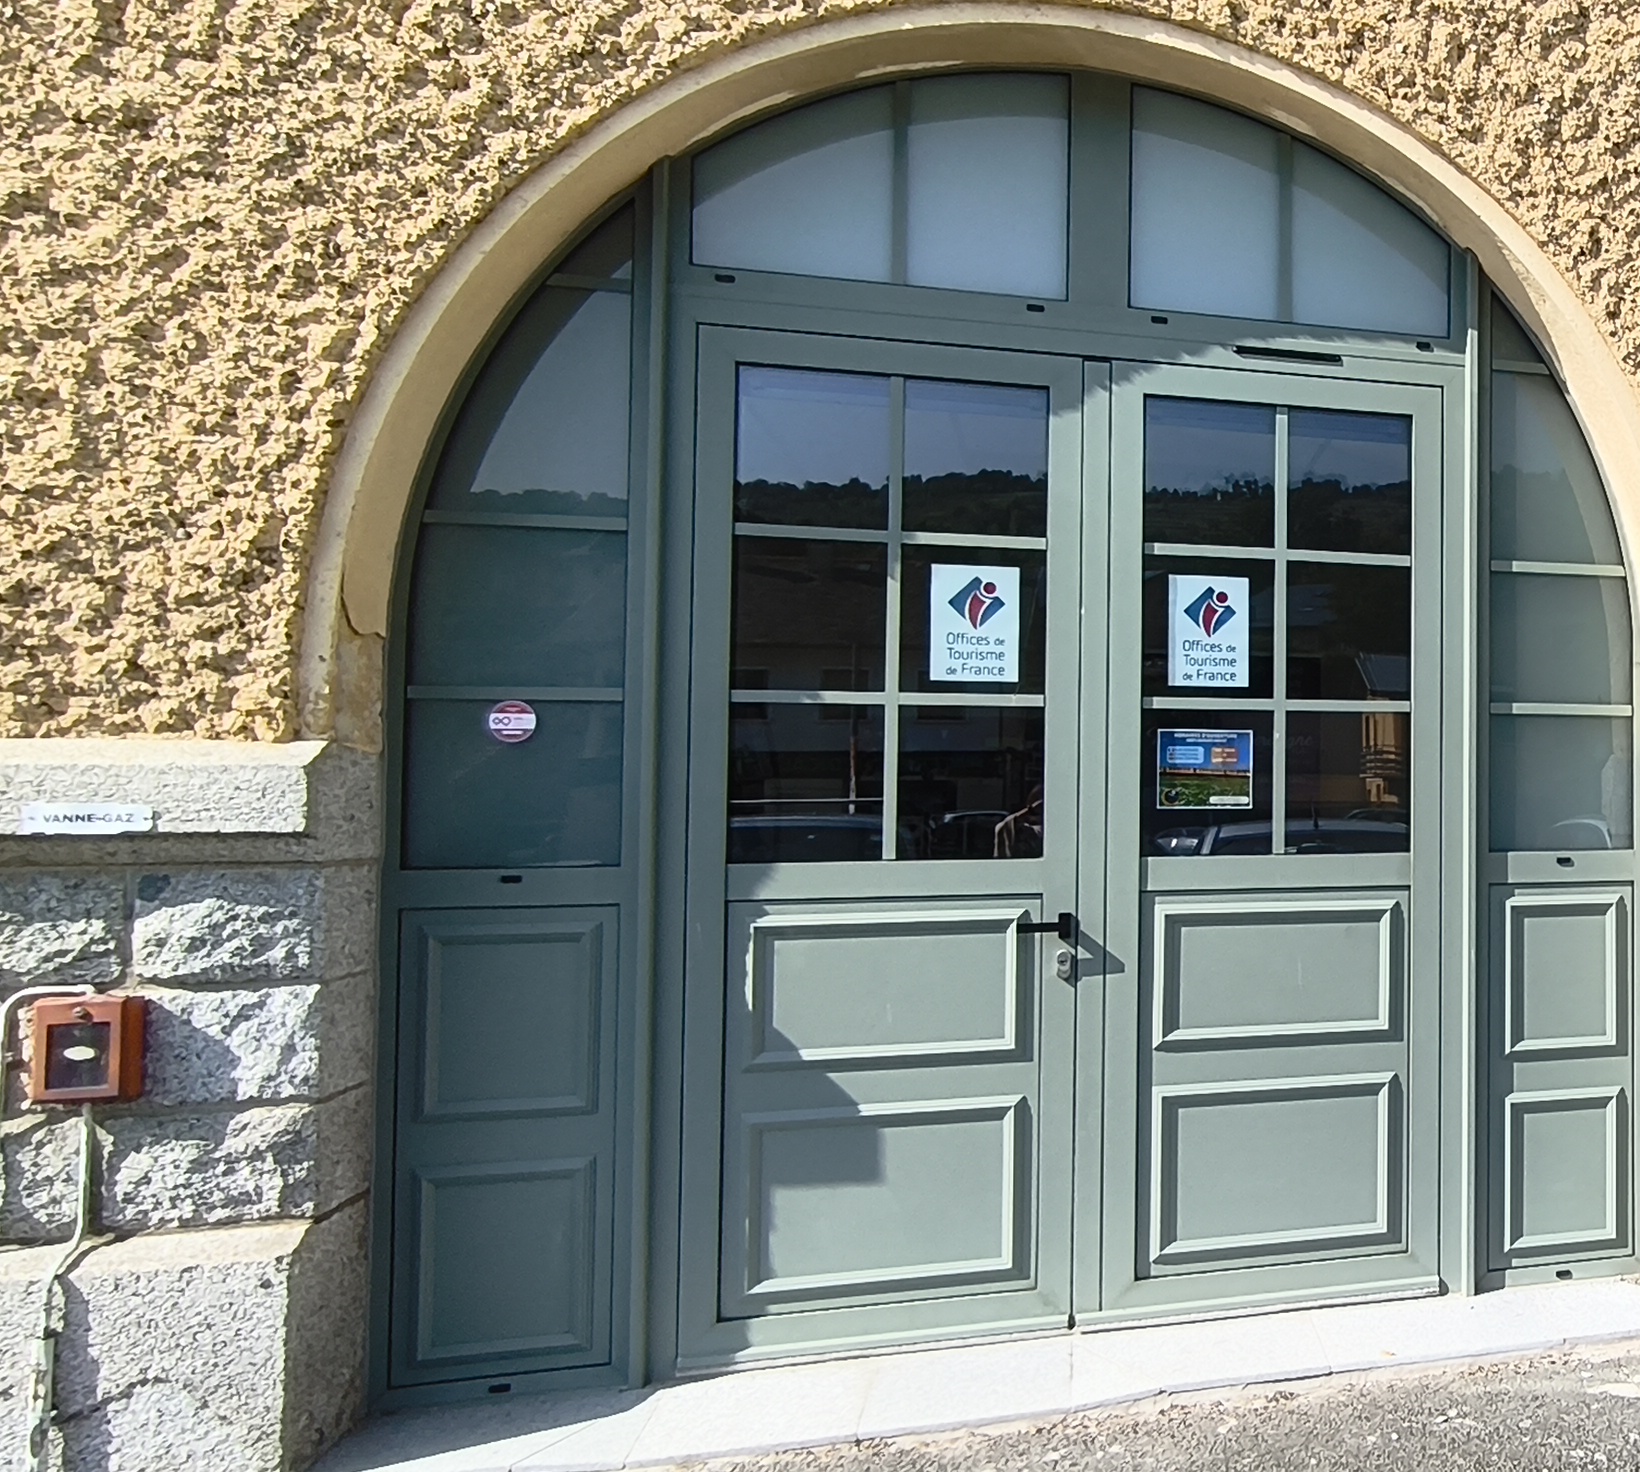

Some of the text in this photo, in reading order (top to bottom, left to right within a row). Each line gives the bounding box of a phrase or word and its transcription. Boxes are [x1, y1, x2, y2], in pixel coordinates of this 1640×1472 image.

[946, 631, 1006, 646] Offices de
[1182, 639, 1237, 653] Offices de
[946, 646, 1006, 661] Tourisme
[1183, 653, 1237, 667] Tourisme
[945, 662, 1006, 676] de France
[1182, 668, 1237, 682] de France
